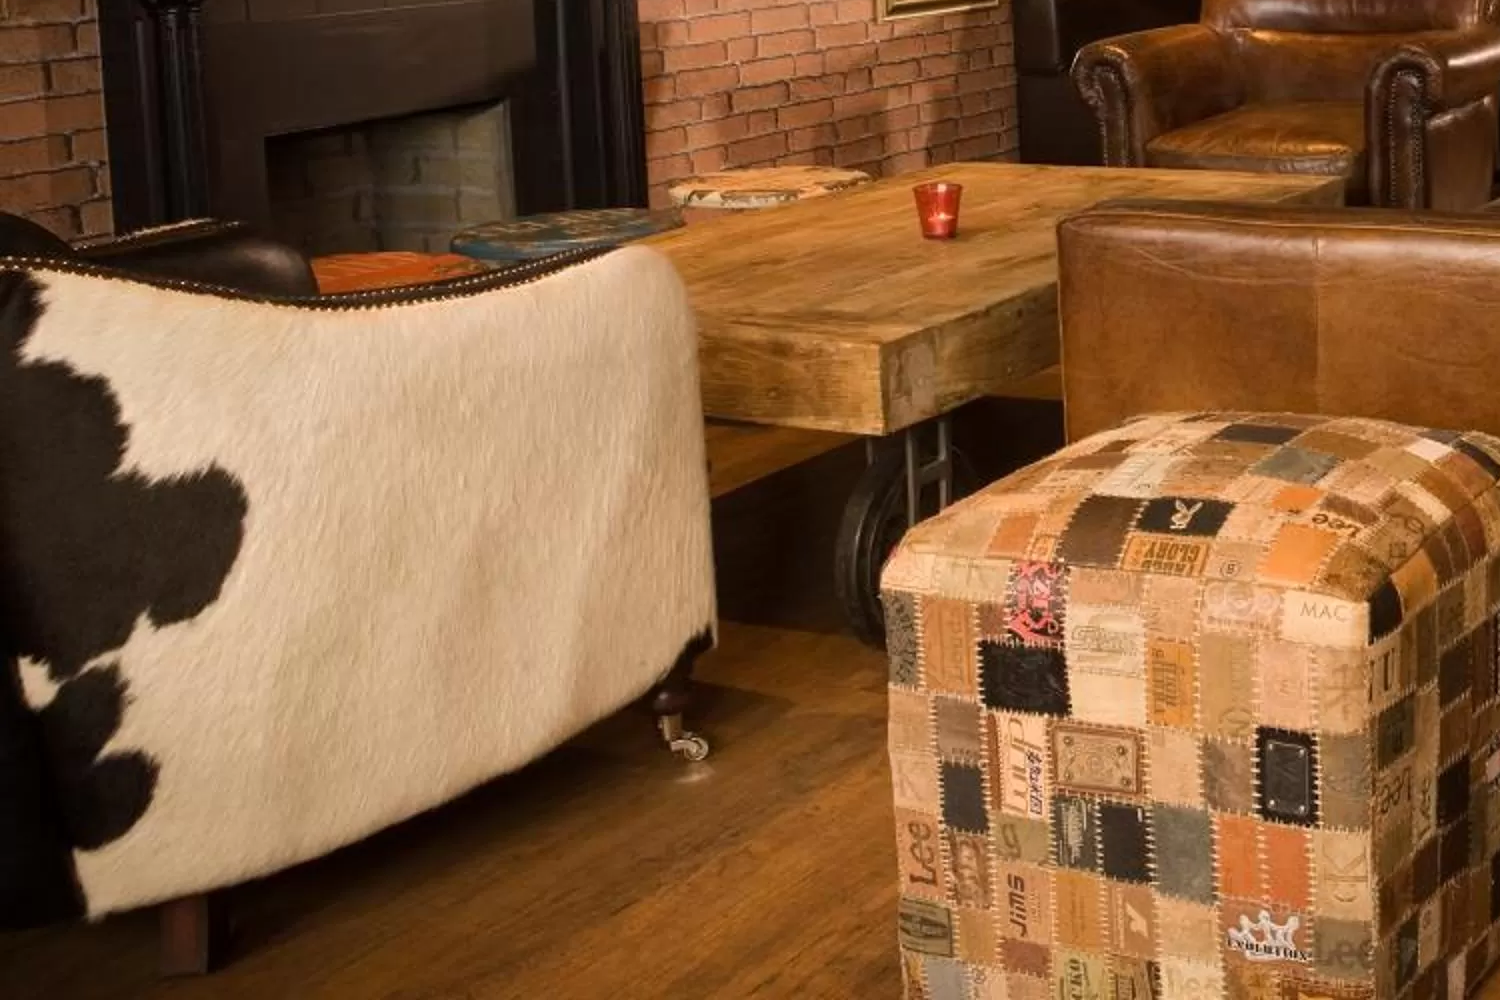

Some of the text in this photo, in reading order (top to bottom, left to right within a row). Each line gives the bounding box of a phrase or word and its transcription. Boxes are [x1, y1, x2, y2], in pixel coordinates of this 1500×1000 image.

[1311, 512, 1361, 539] Lee
[1299, 600, 1350, 624] MAC
[909, 822, 939, 888] Lee
